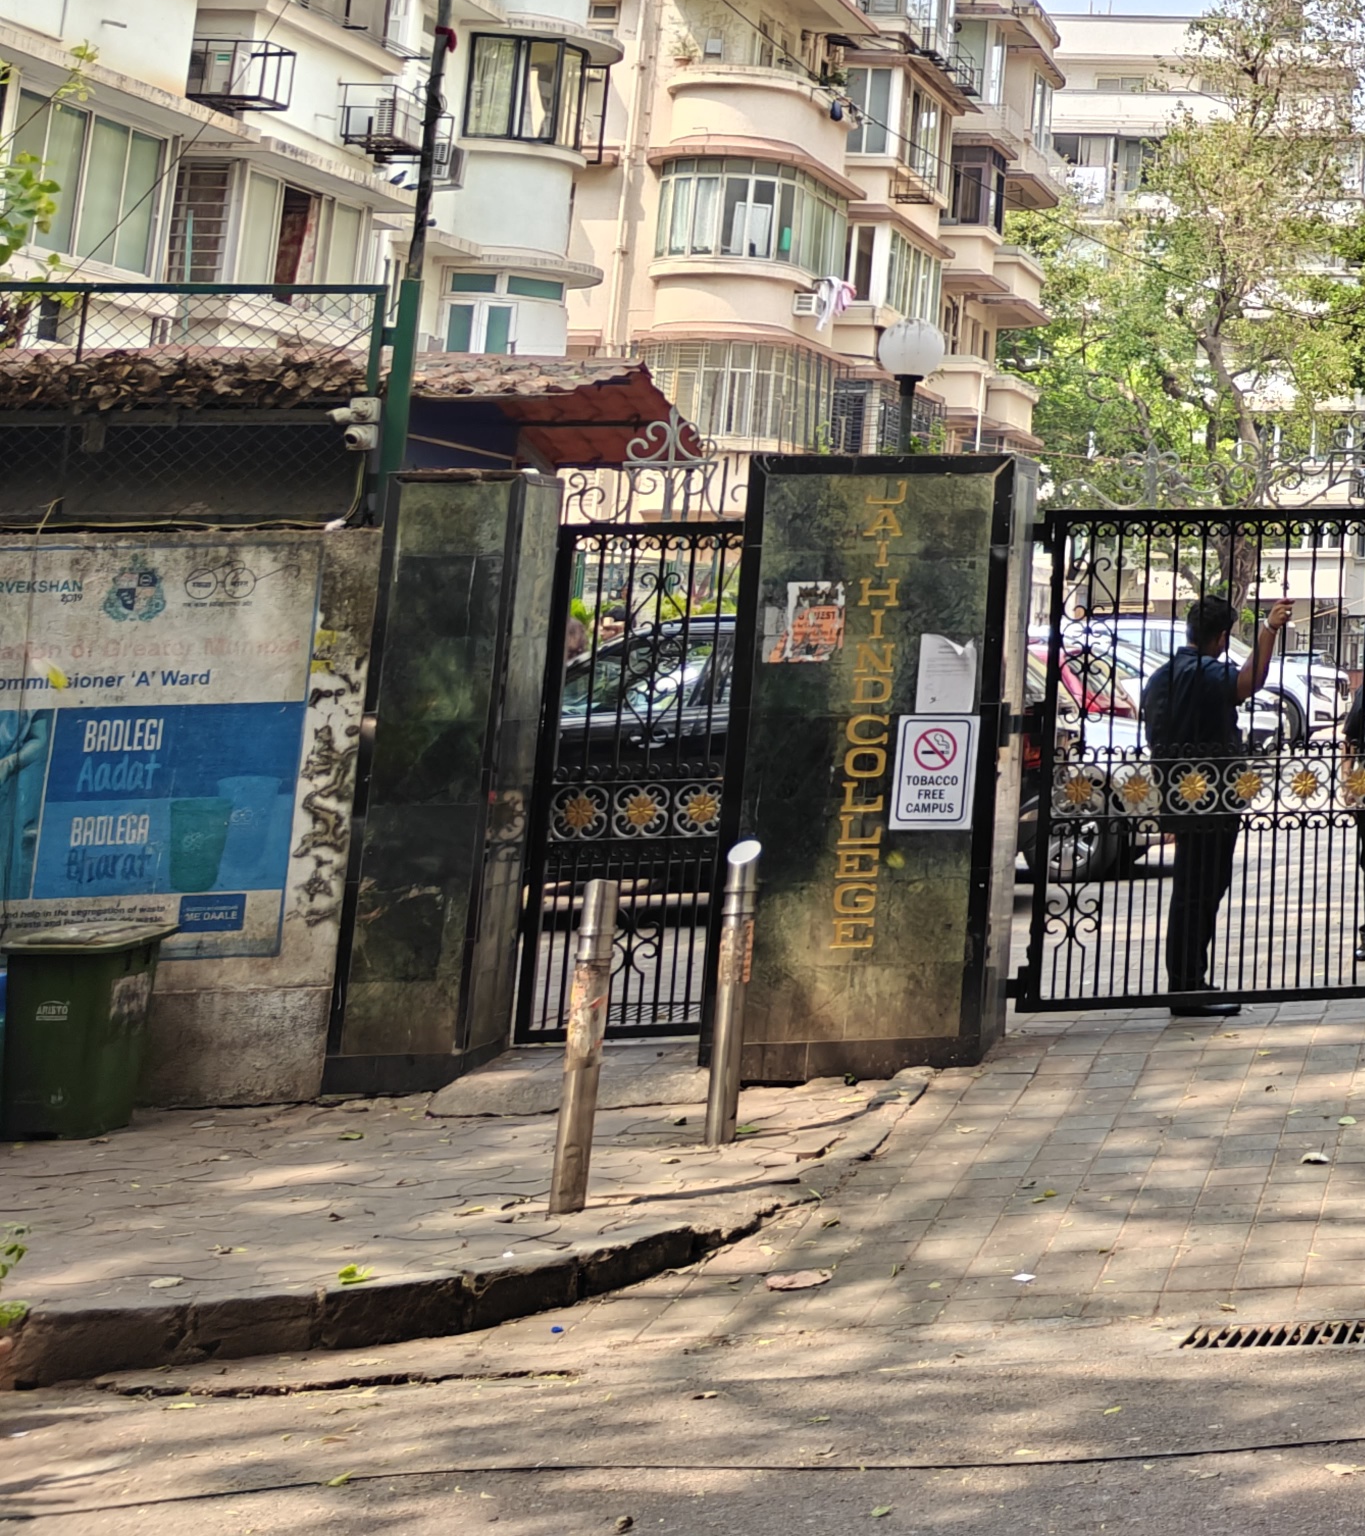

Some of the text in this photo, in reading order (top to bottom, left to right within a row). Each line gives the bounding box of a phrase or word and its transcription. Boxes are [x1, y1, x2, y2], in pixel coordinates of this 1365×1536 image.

[60, 593, 83, 606] 2019
[160, 669, 211, 686] Ward
[828, 480, 908, 951] JAI HIND COLLEGE
[83, 718, 164, 753] BADLEGI
[76, 753, 161, 793] Aadat
[906, 775, 959, 786] TOBACCO
[917, 789, 946, 800] FREE
[905, 803, 954, 813] CAMPUS
[70, 814, 150, 847] BADLEGA
[66, 848, 152, 884] Bharat
